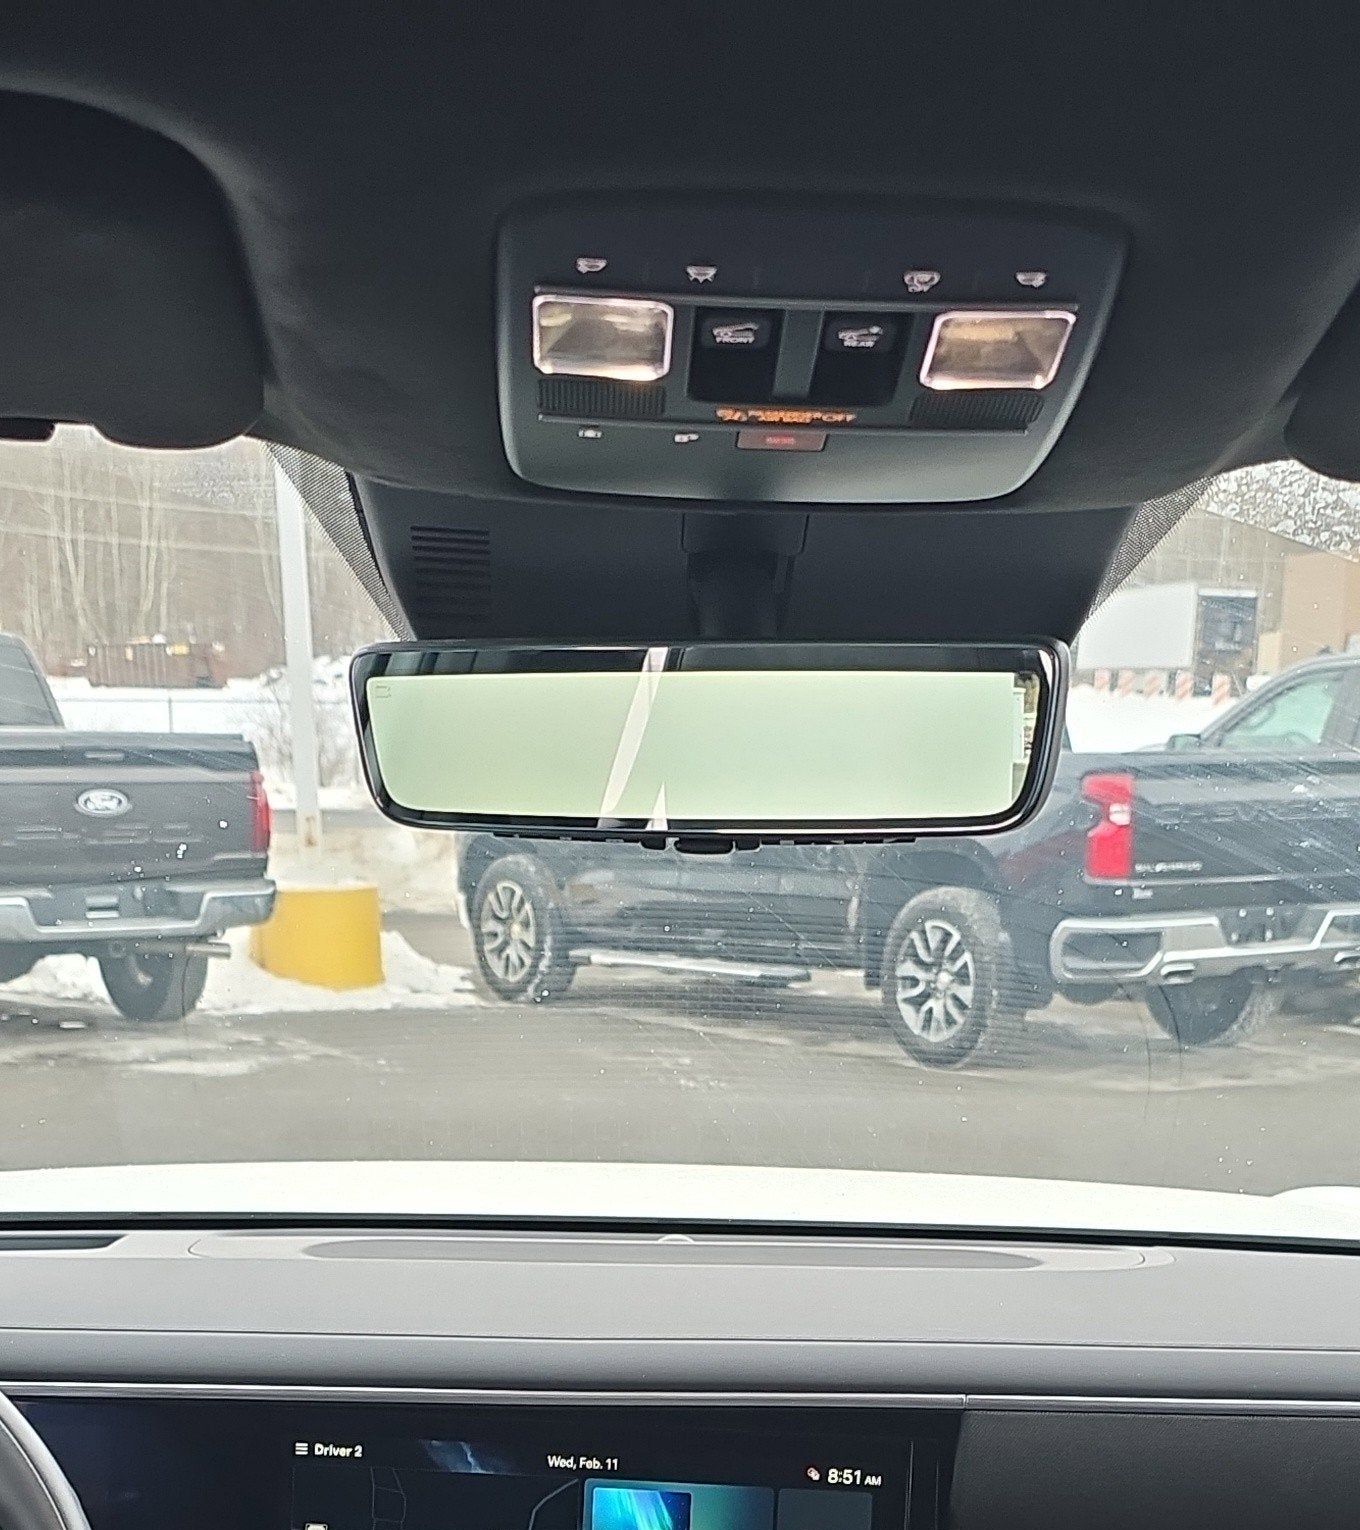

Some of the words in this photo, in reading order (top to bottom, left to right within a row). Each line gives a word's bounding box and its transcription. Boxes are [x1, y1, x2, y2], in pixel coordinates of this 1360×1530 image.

[314, 1443, 353, 1458] Driver
[354, 1445, 363, 1458] 2
[547, 1455, 577, 1470] Wed,
[579, 1457, 603, 1470] Feb.
[605, 1458, 618, 1471] 11
[827, 1468, 861, 1485] 8:51
[864, 1475, 882, 1486] AM
